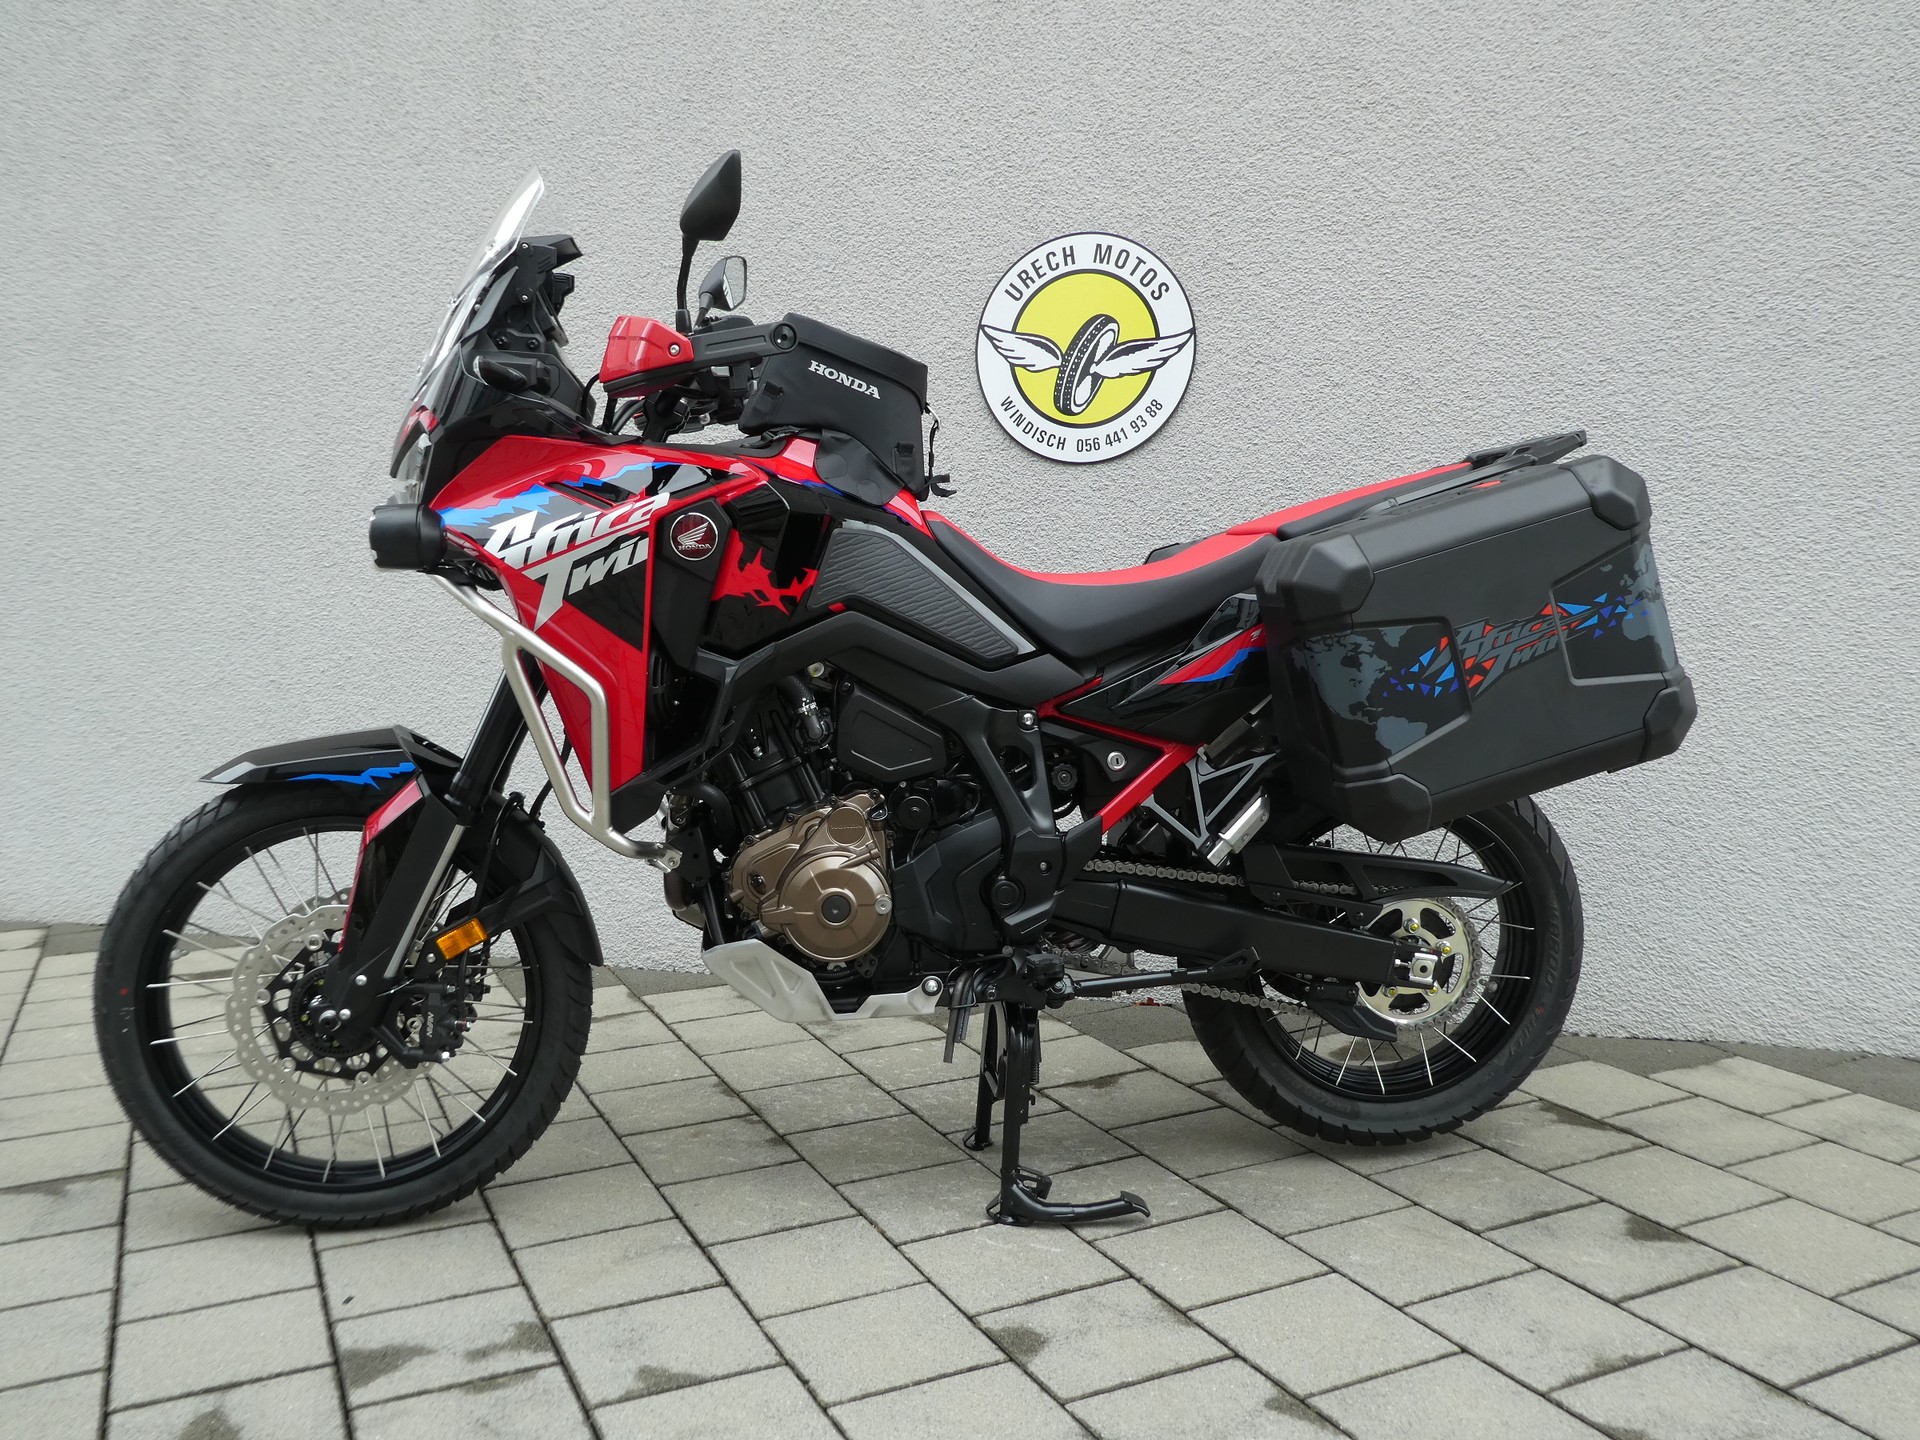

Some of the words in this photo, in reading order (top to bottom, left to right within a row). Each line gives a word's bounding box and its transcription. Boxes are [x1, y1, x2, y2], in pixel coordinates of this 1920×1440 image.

[1004, 245, 1077, 302] URECH
[1093, 243, 1170, 301] MOTOS
[808, 360, 881, 399] HONDA
[1000, 396, 1067, 451] WINDISCH
[1076, 437, 1101, 453] 056
[1105, 429, 1130, 448] 441
[1130, 414, 1148, 434] 93
[1146, 399, 1164, 418] 88
[484, 492, 670, 570] Africa
[677, 543, 712, 551] HONDA
